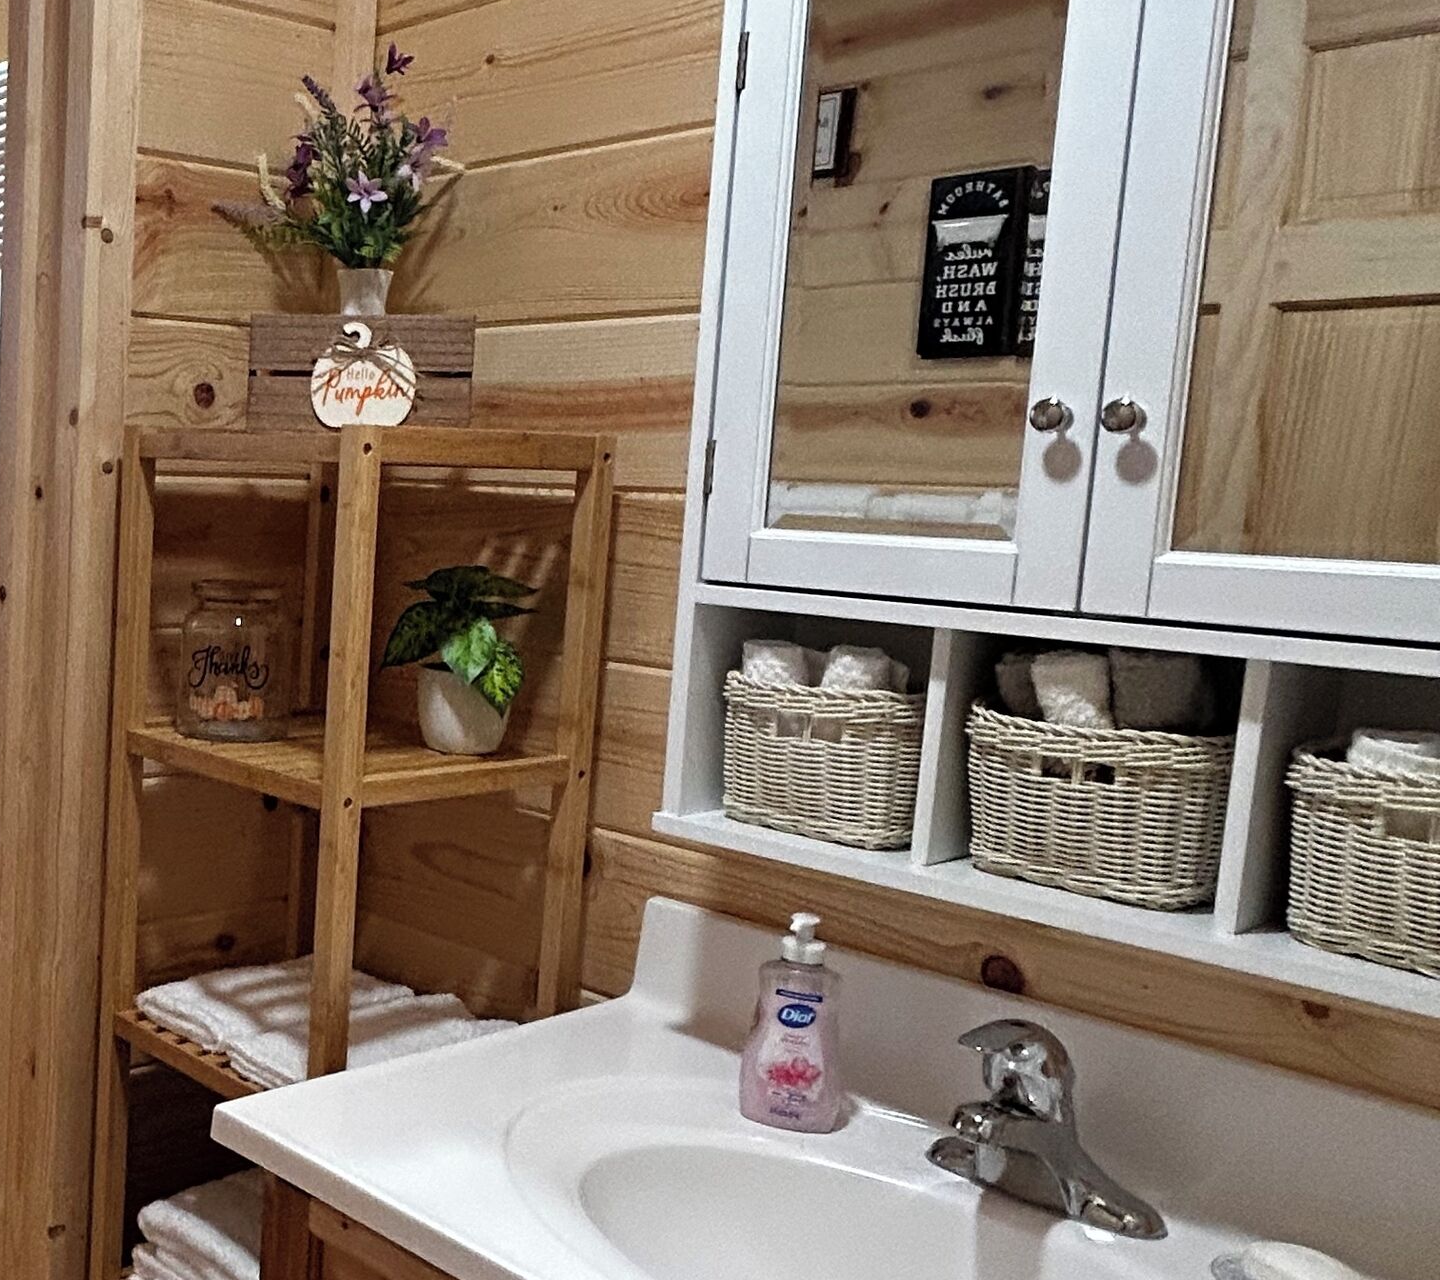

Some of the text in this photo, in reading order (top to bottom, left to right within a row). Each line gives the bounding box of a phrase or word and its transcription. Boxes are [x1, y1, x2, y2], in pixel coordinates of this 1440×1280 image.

[323, 369, 406, 415] Pumpkin
[346, 369, 376, 381] Hello
[188, 645, 269, 690] Thanks
